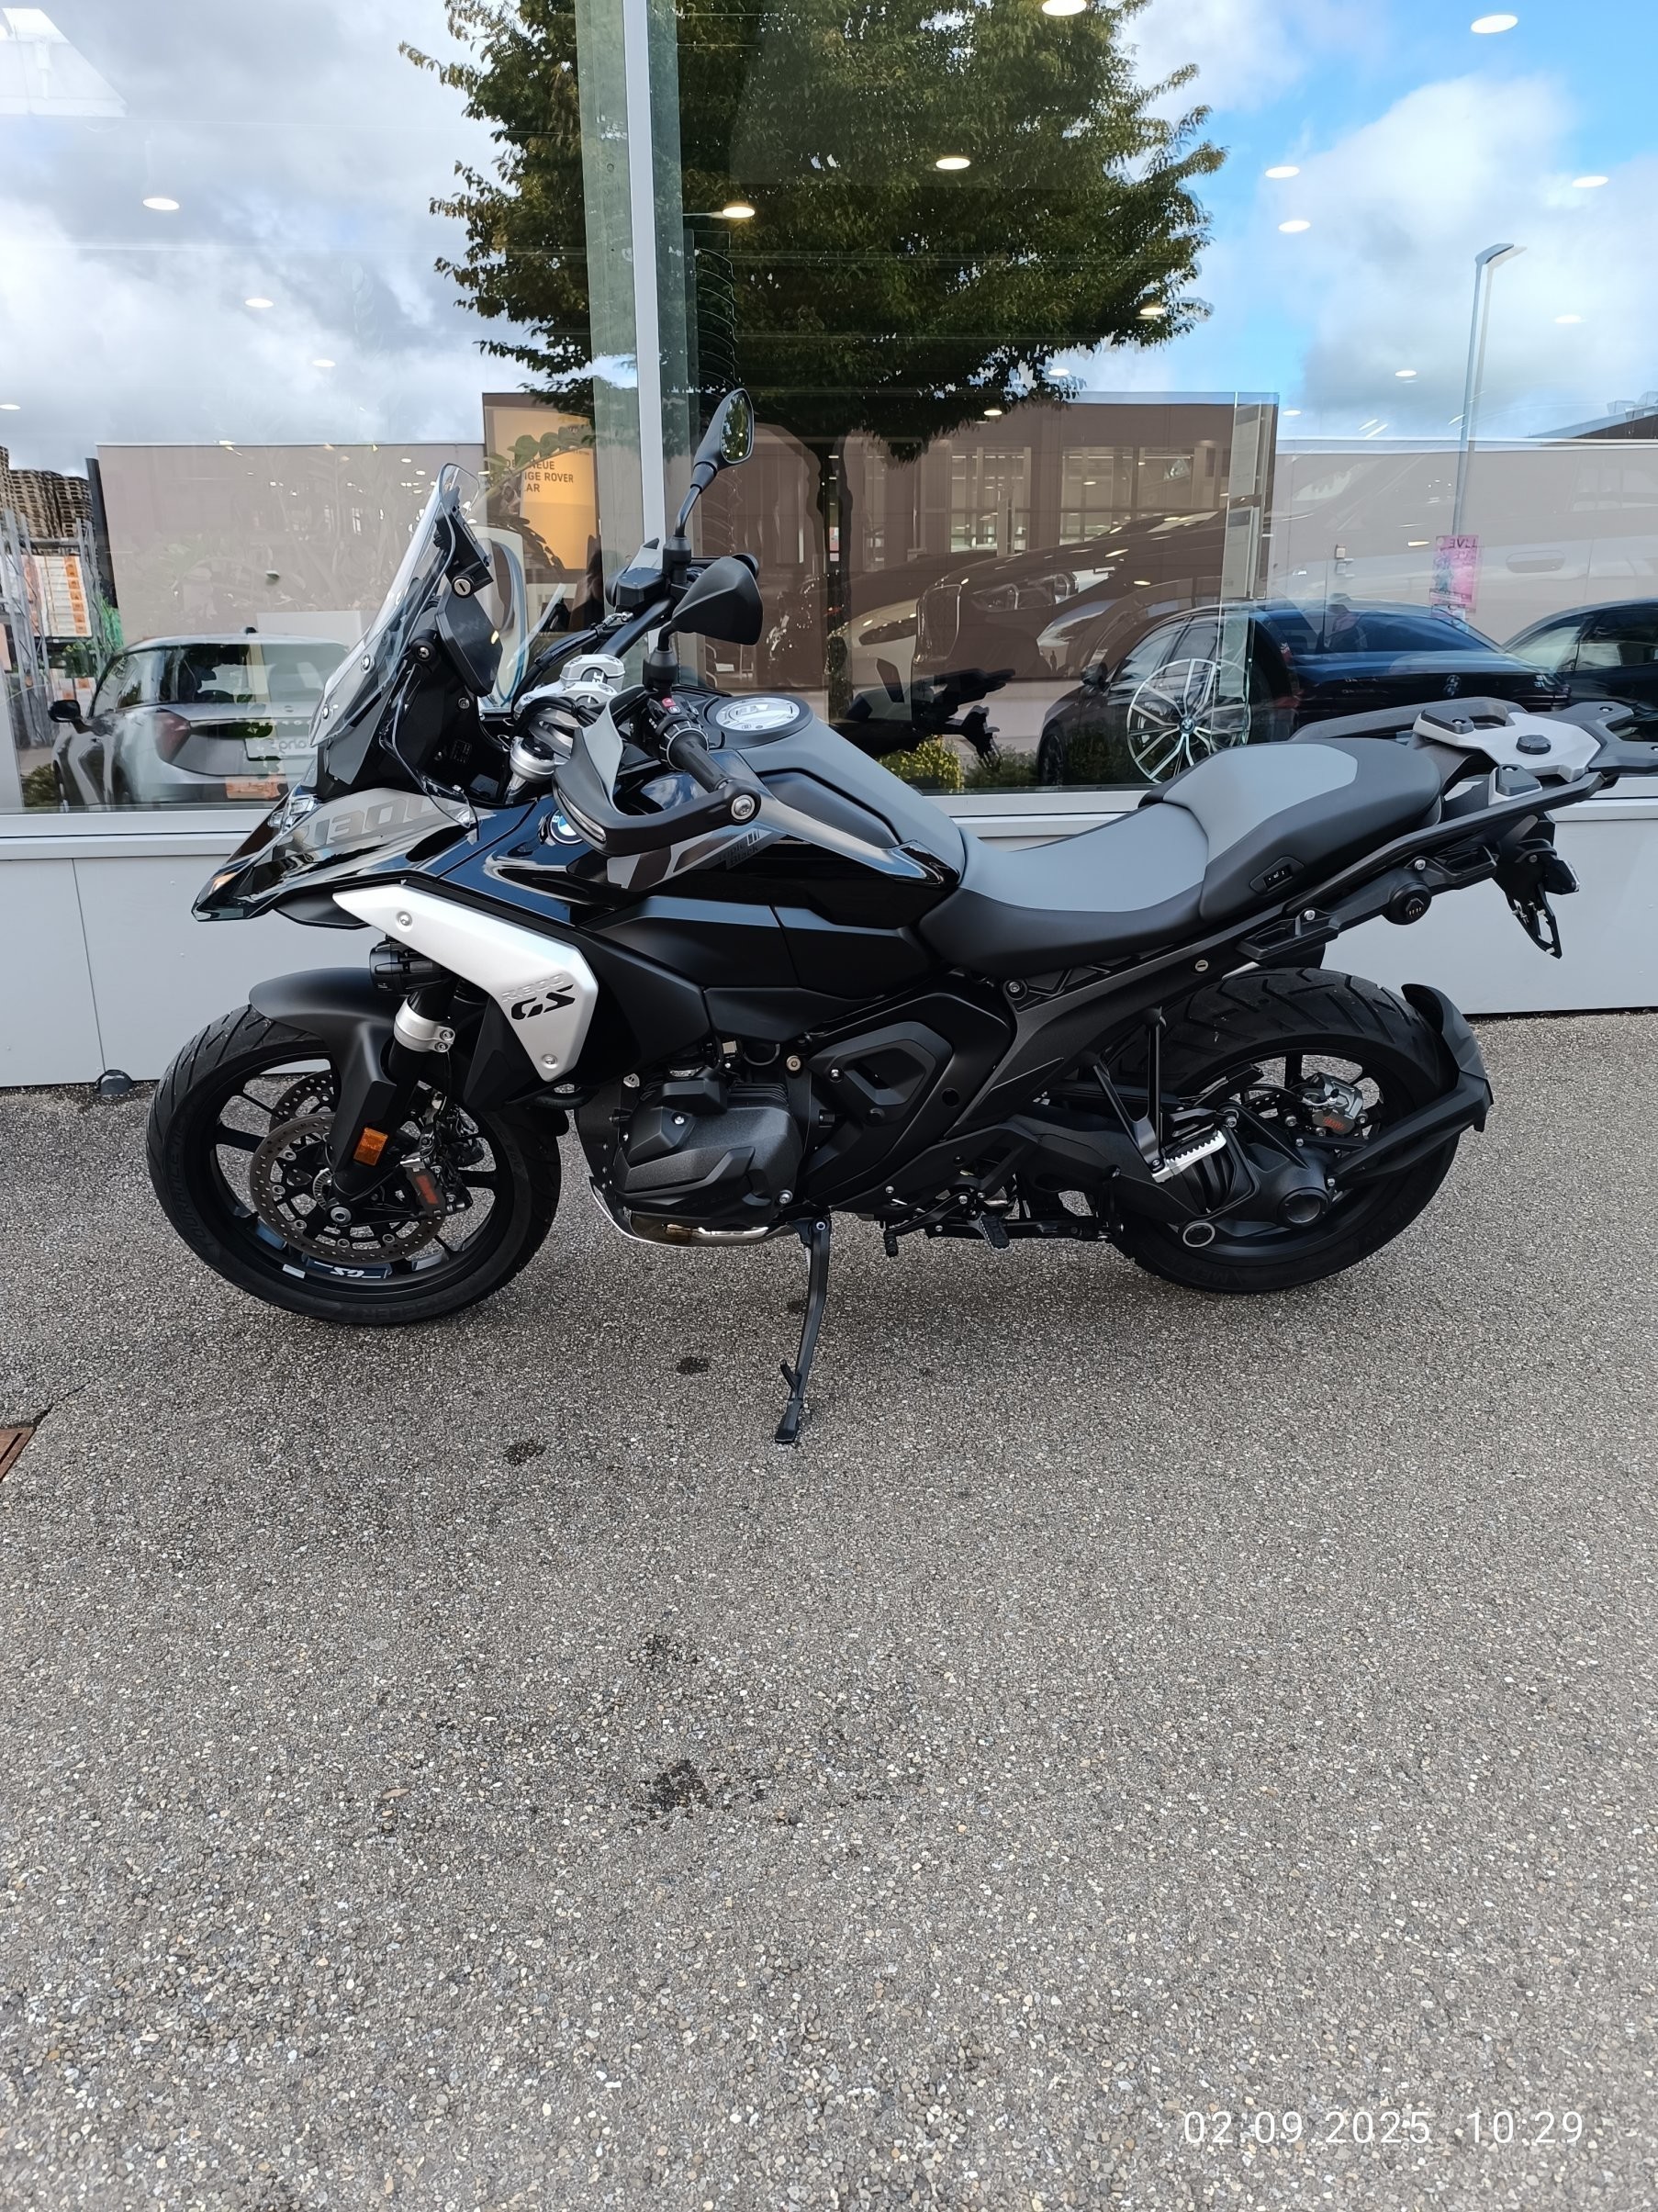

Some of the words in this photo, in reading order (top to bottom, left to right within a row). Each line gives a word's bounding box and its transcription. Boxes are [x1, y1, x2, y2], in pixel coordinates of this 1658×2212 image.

[544, 473, 574, 483] ROVER
[511, 984, 576, 1020] GS
[330, 1267, 365, 1278] GS
